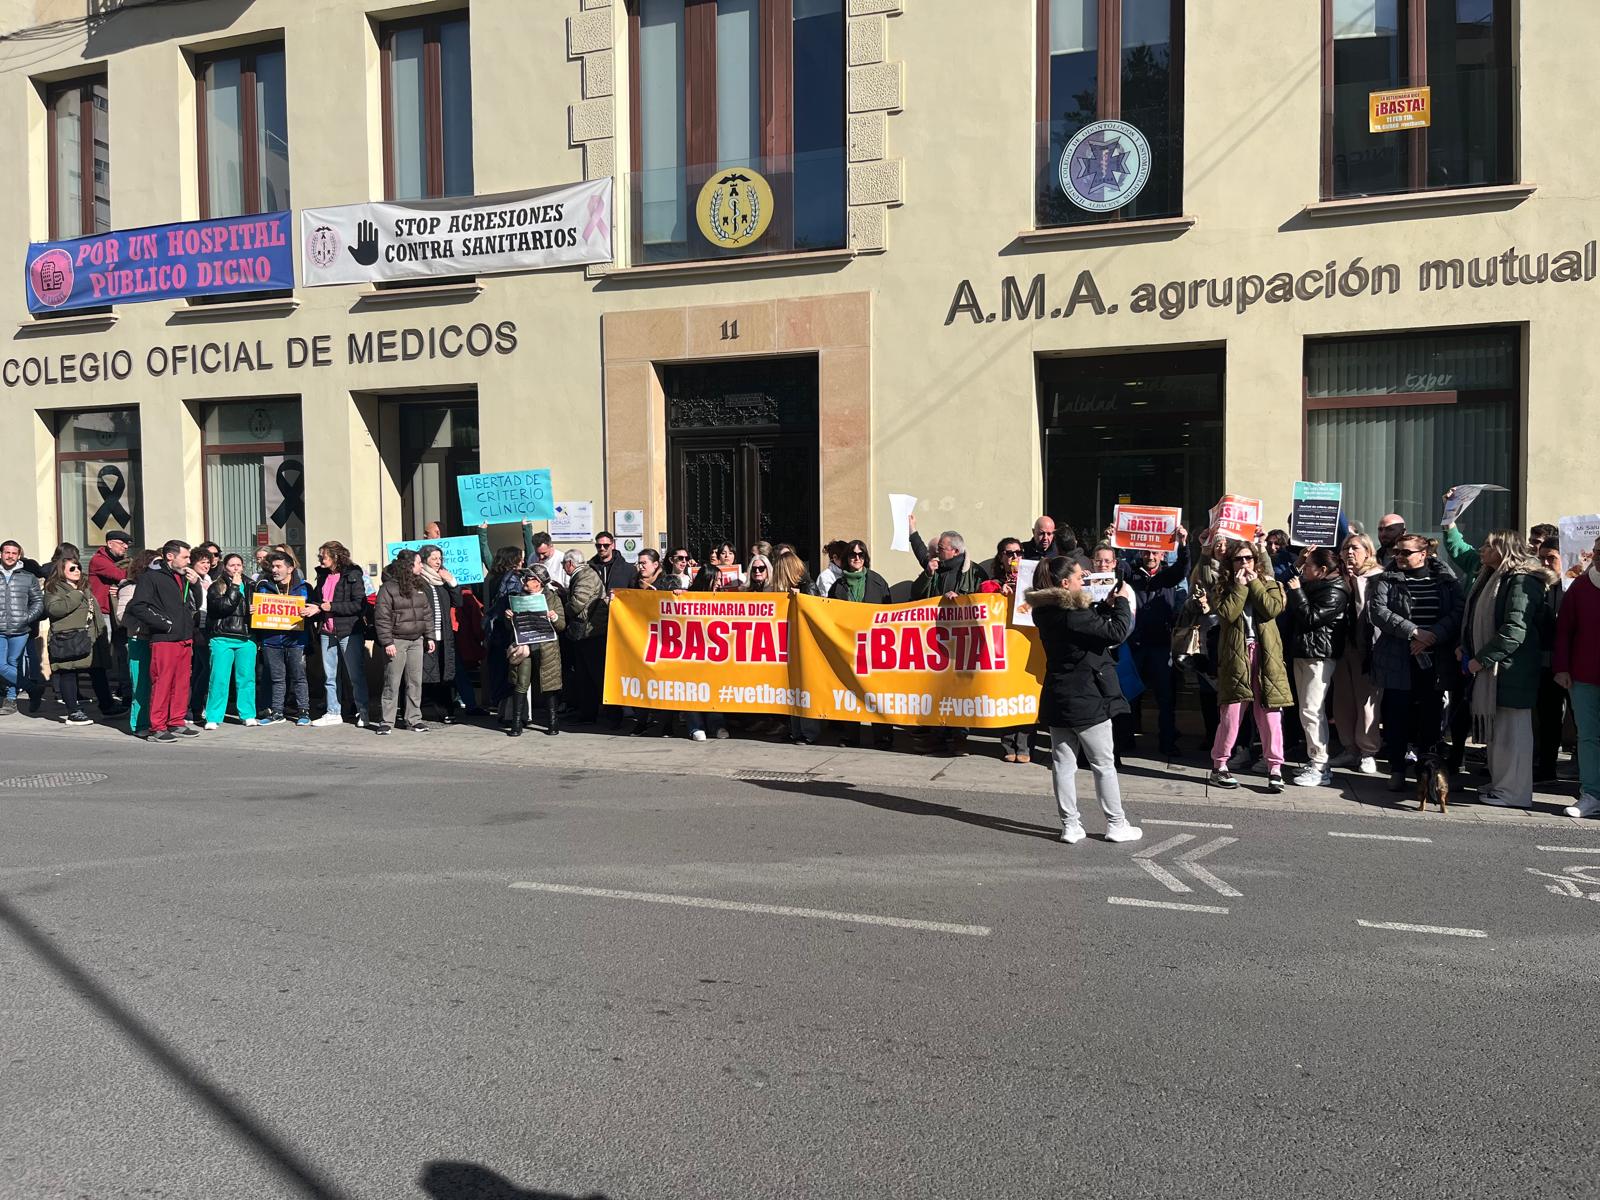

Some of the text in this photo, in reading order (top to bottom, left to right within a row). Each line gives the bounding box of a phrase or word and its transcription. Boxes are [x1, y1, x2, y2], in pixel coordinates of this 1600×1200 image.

[1376, 98, 1425, 116] ¡BASTA!
[1062, 149, 1073, 179] COLEGIO
[1072, 137, 1082, 147] DE
[395, 203, 564, 238] STOP AGRESIONES
[75, 239, 120, 267] POR
[128, 233, 158, 261] UN
[166, 221, 286, 257] HOSPITAL
[385, 227, 577, 263] CONTRA SANITARIOS
[90, 263, 187, 298] PÚBLICO
[944, 240, 1597, 326] A.M.A. agrupación mutual
[719, 320, 740, 341] 11
[2, 321, 518, 387] COLEGIO OFICIAL DE MEDICOS
[464, 474, 540, 490] LIBERTAD DE
[477, 487, 543, 502] CRITERIO
[1127, 519, 1168, 532] ¡BASTA!
[258, 603, 301, 616] ¡BASTA!
[661, 602, 774, 616] LA VETERINARIA DICE
[874, 605, 987, 624] LA VETERINARIA DICE
[645, 620, 789, 663] ¡BASTA!
[856, 625, 1006, 675] ¡BASTA!
[621, 677, 810, 708] YO, CIERRO #vetbasta
[832, 689, 1037, 717] YO, CIERRO #vetbasta
